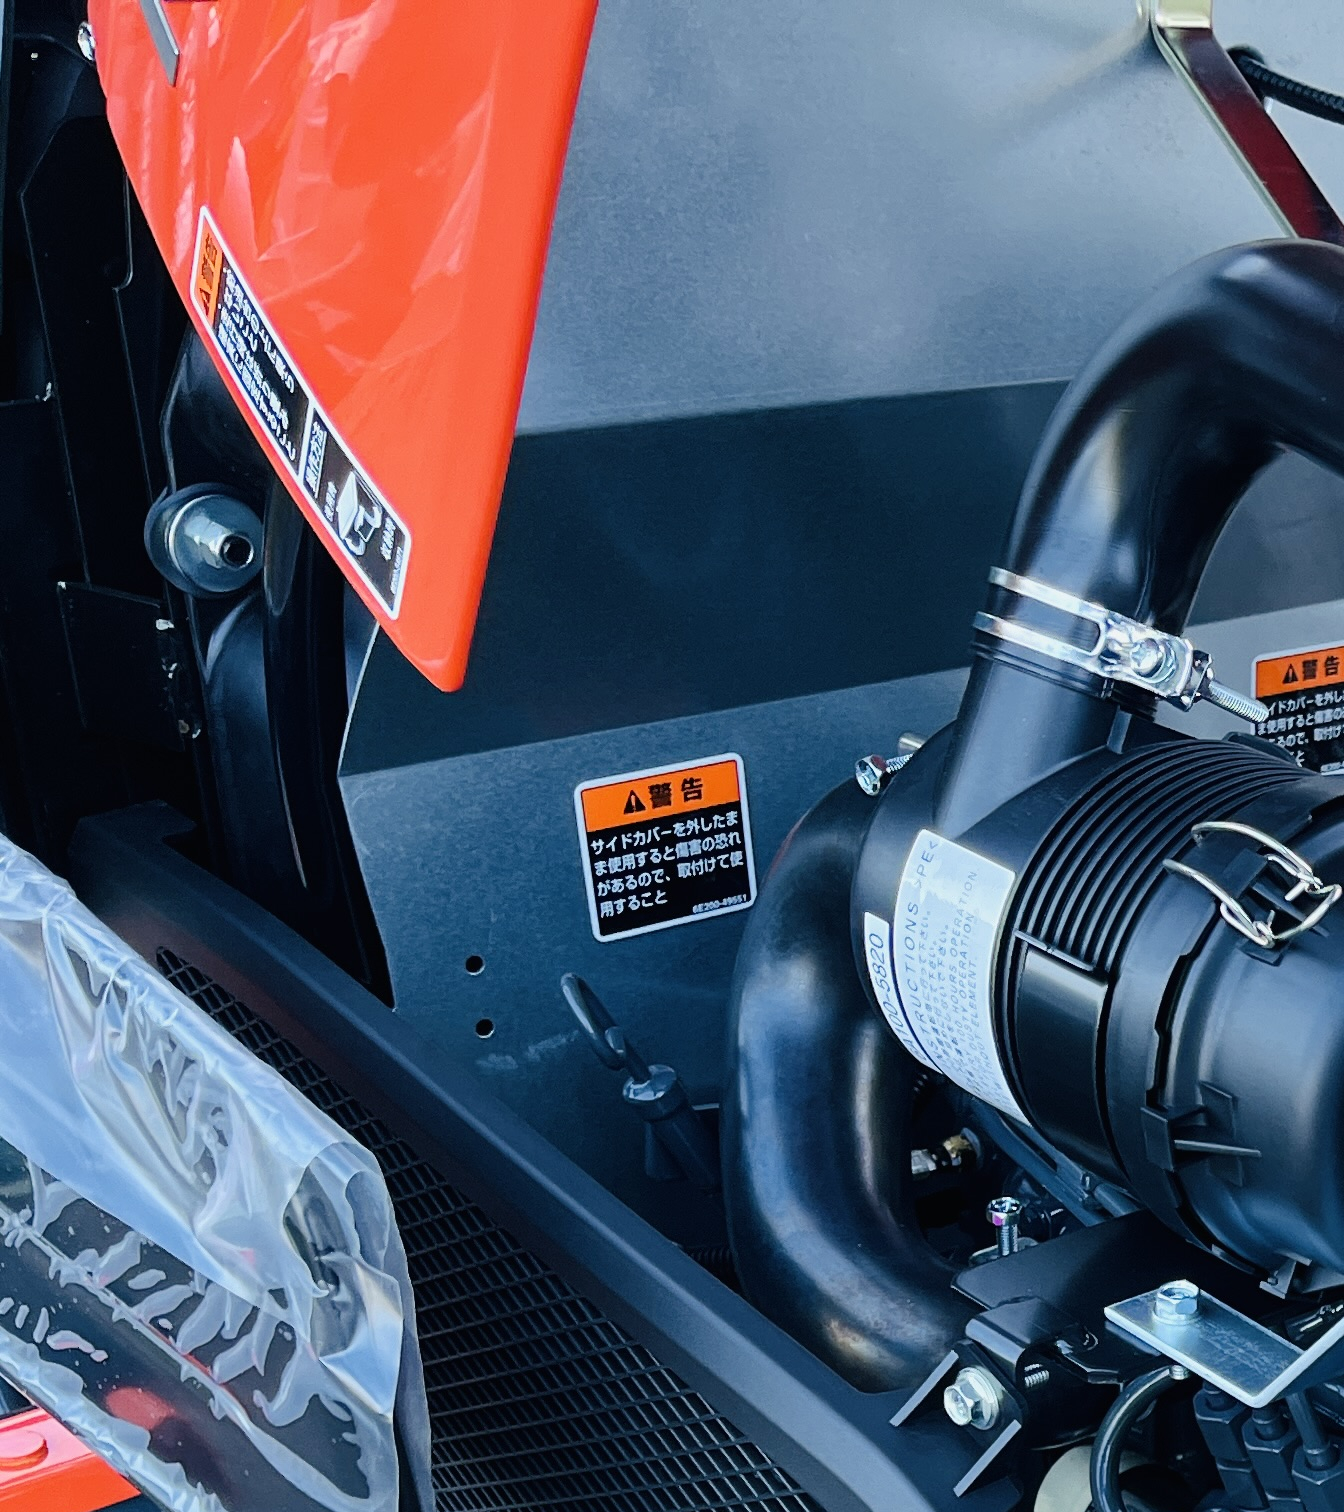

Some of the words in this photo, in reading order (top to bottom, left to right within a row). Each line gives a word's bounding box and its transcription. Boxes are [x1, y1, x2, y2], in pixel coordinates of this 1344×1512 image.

[1302, 656, 1341, 680] 警告
[648, 777, 704, 809] 警告
[590, 810, 739, 856] サイドカバーを外したま
[594, 831, 742, 876] ま使用すると傷害の恐れ
[600, 890, 668, 918] 用すること
[949, 870, 978, 957] OPERATION
[958, 912, 975, 998] OPERATION
